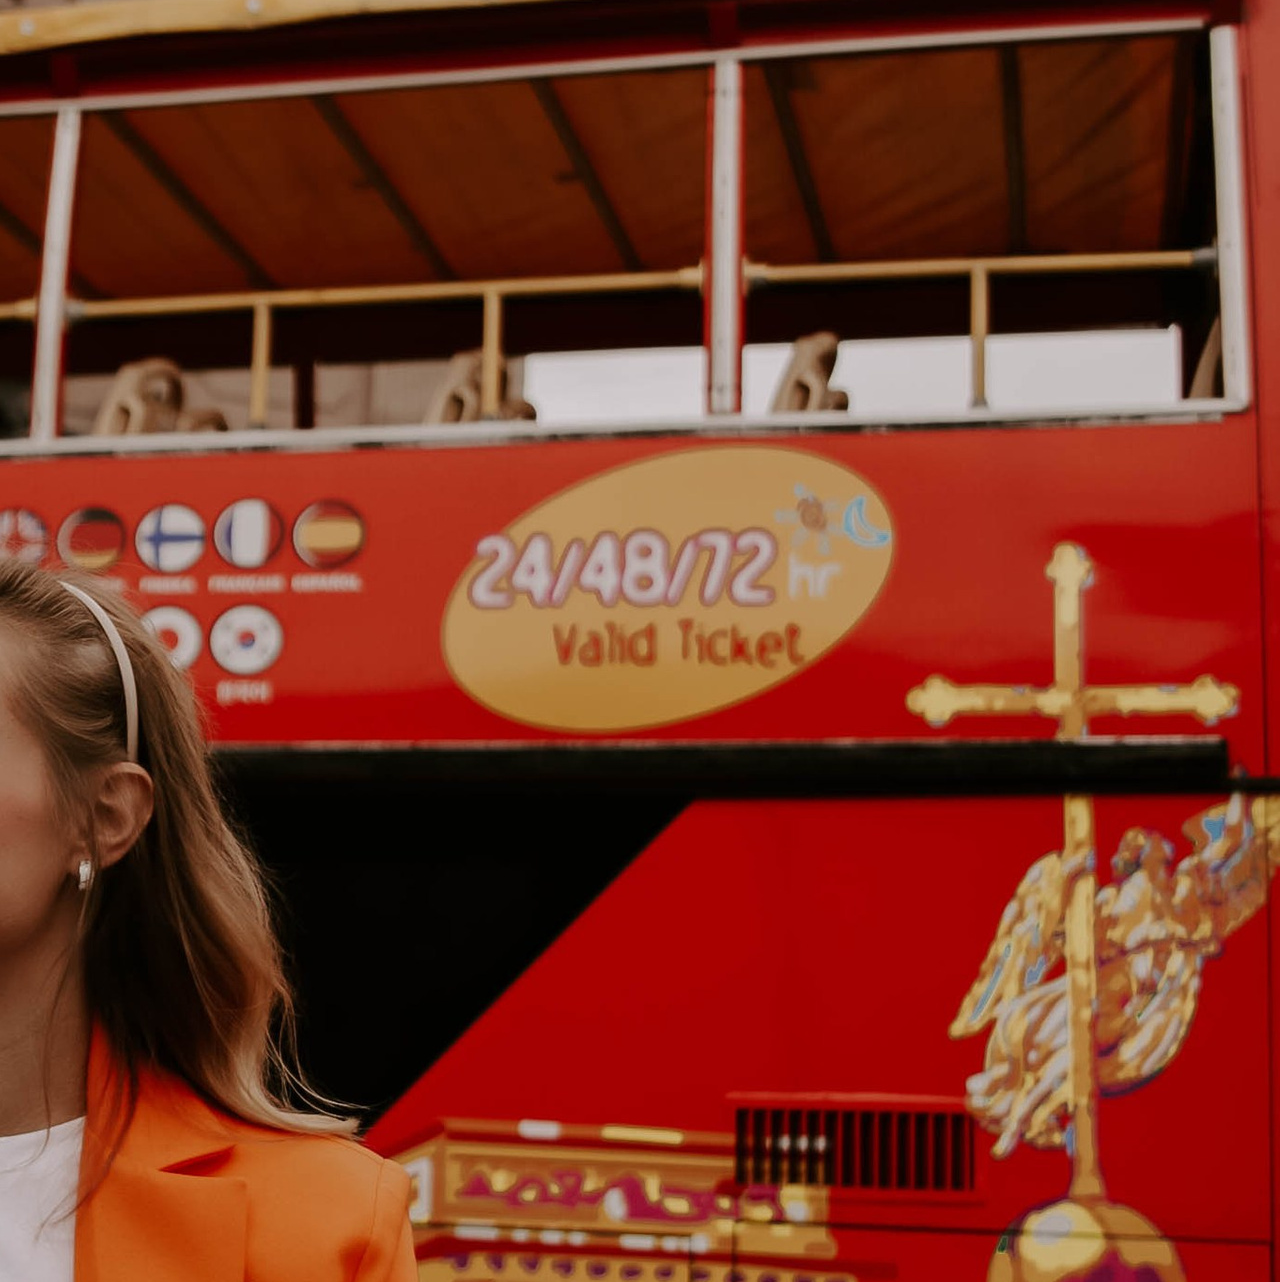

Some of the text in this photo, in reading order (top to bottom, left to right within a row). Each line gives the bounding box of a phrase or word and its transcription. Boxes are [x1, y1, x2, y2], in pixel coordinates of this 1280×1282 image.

[467, 526, 843, 610] 24/48/72 hr
[552, 617, 806, 669] Valid Ticket
